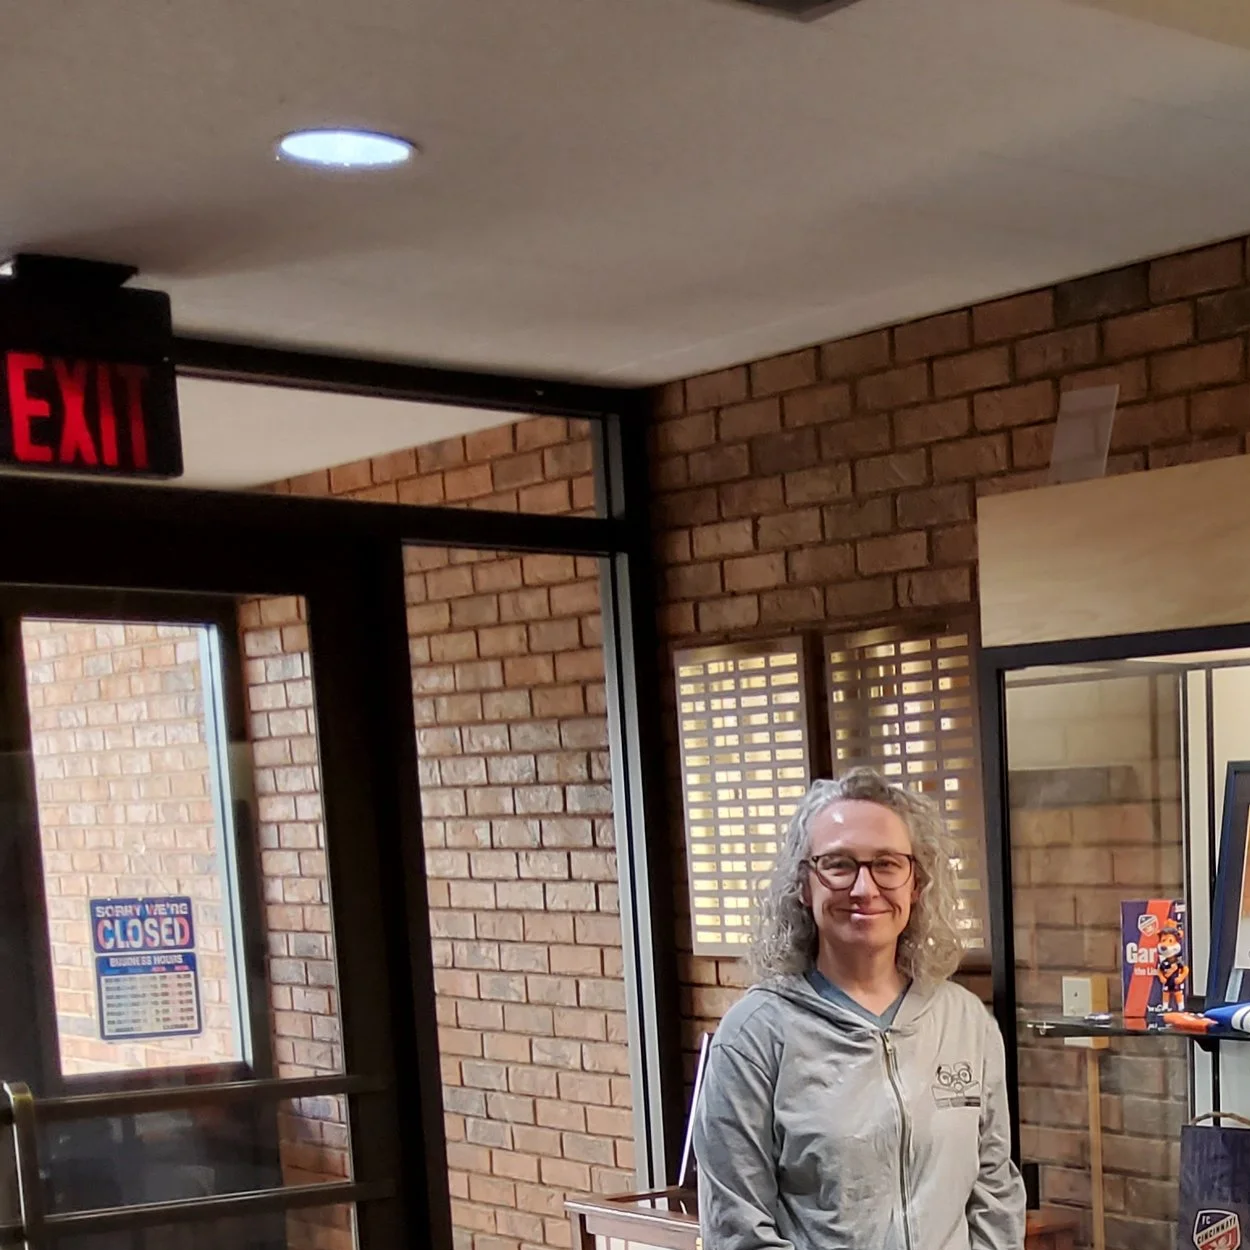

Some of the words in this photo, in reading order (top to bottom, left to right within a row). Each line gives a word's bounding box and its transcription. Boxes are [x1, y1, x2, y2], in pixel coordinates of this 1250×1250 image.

[6, 351, 149, 469] EXIT
[95, 905, 141, 918] SORRY
[97, 917, 190, 949] CLOSED
[1126, 942, 1159, 964] Gar
